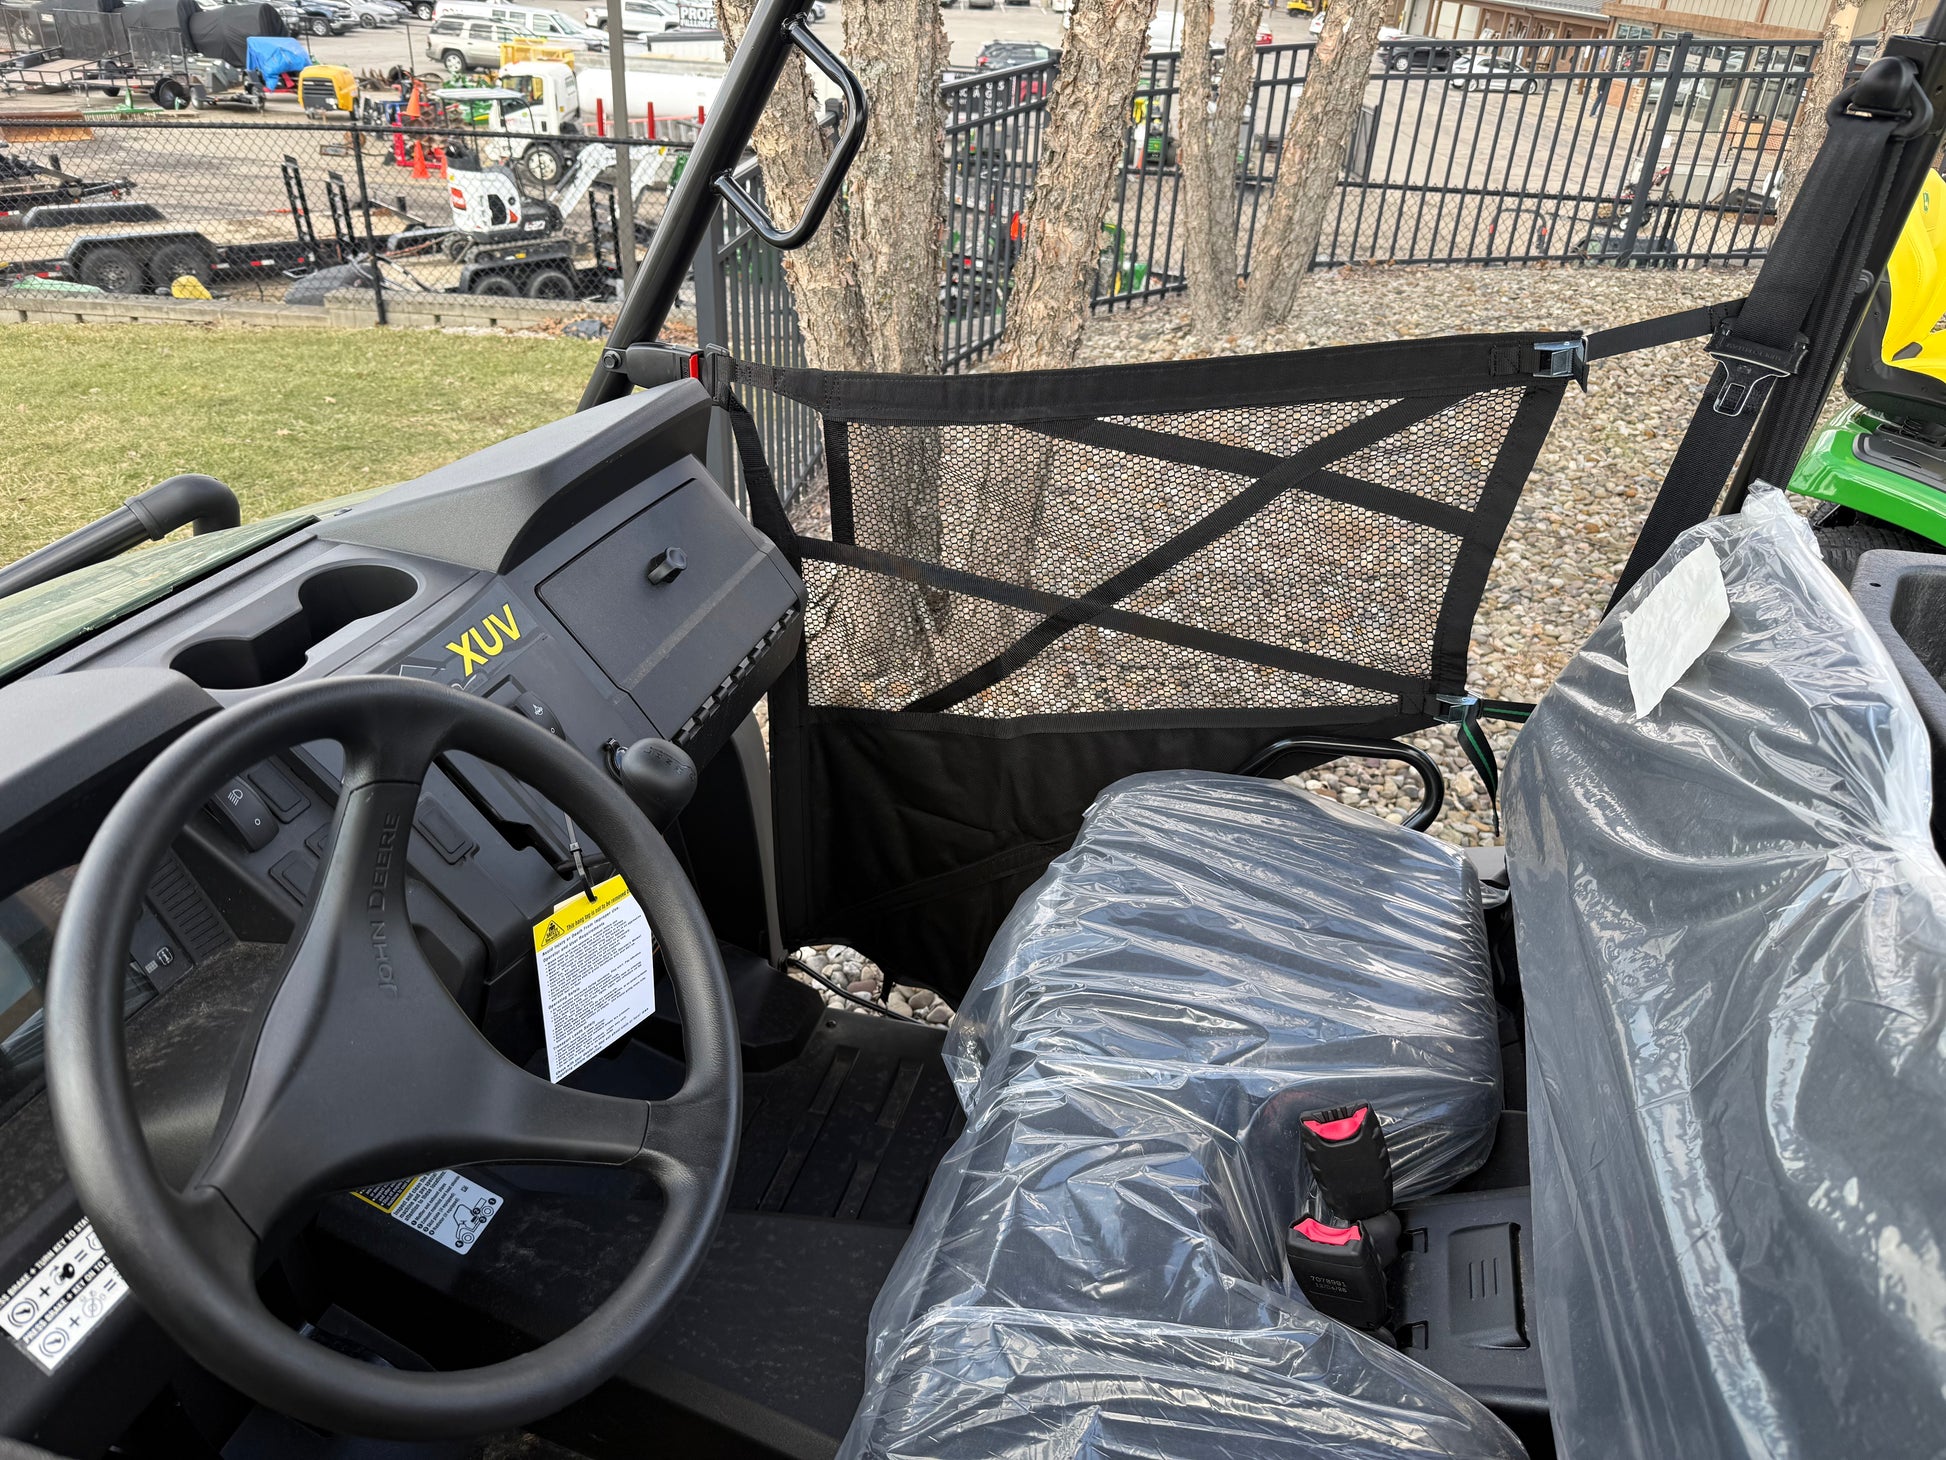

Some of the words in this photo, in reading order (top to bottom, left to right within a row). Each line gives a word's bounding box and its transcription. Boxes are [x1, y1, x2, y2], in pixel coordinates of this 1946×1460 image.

[681, 7, 717, 20] PROP
[445, 603, 521, 677] XUV
[367, 812, 401, 912] DEERE
[370, 920, 399, 999] JOHN
[52, 1237, 67, 1253] KEY
[64, 1229, 77, 1240] TO
[71, 1279, 87, 1295] KEY
[83, 1269, 97, 1283] ON
[93, 1260, 106, 1272] TO
